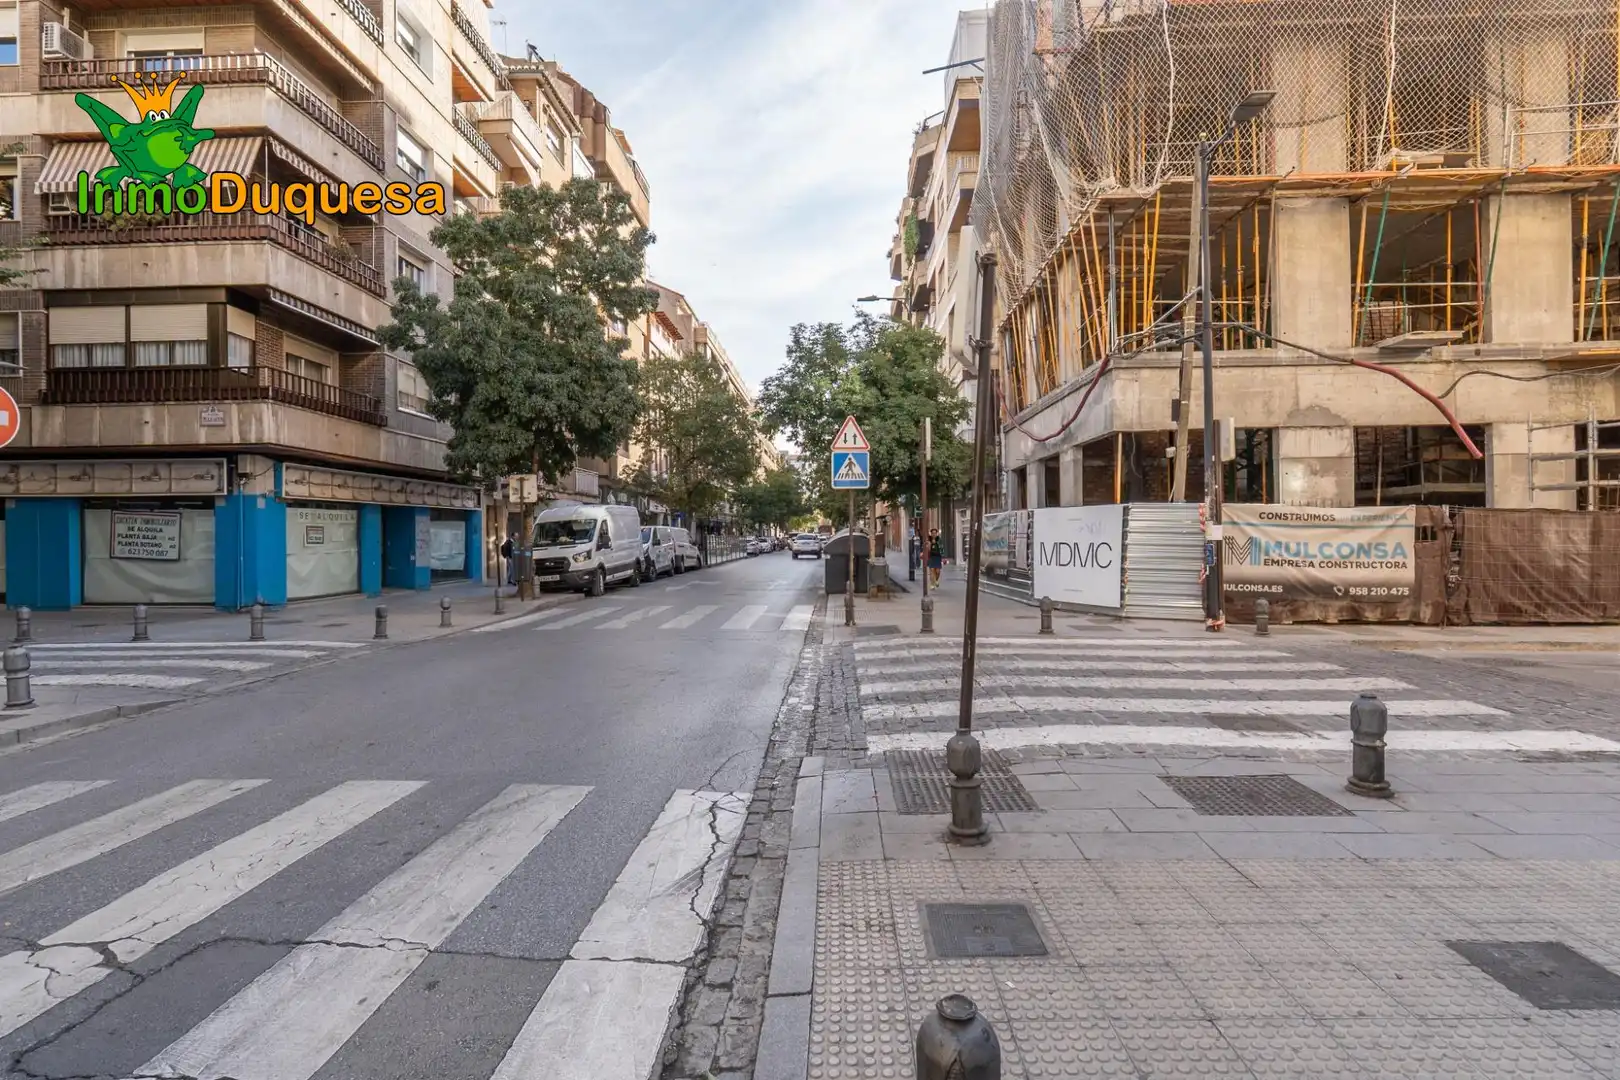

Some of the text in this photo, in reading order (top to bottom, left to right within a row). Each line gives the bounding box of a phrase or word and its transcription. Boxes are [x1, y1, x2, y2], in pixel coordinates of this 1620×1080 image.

[299, 511, 356, 521] SE ALQUILA
[1259, 511, 1336, 522] CONSTRUIMOS
[1039, 541, 1113, 569] MDMC
[1264, 541, 1408, 560] MULCONSA
[1263, 559, 1408, 570] EMPRESA CONSTRUCTORA
[1349, 586, 1410, 596] 958 210 475
